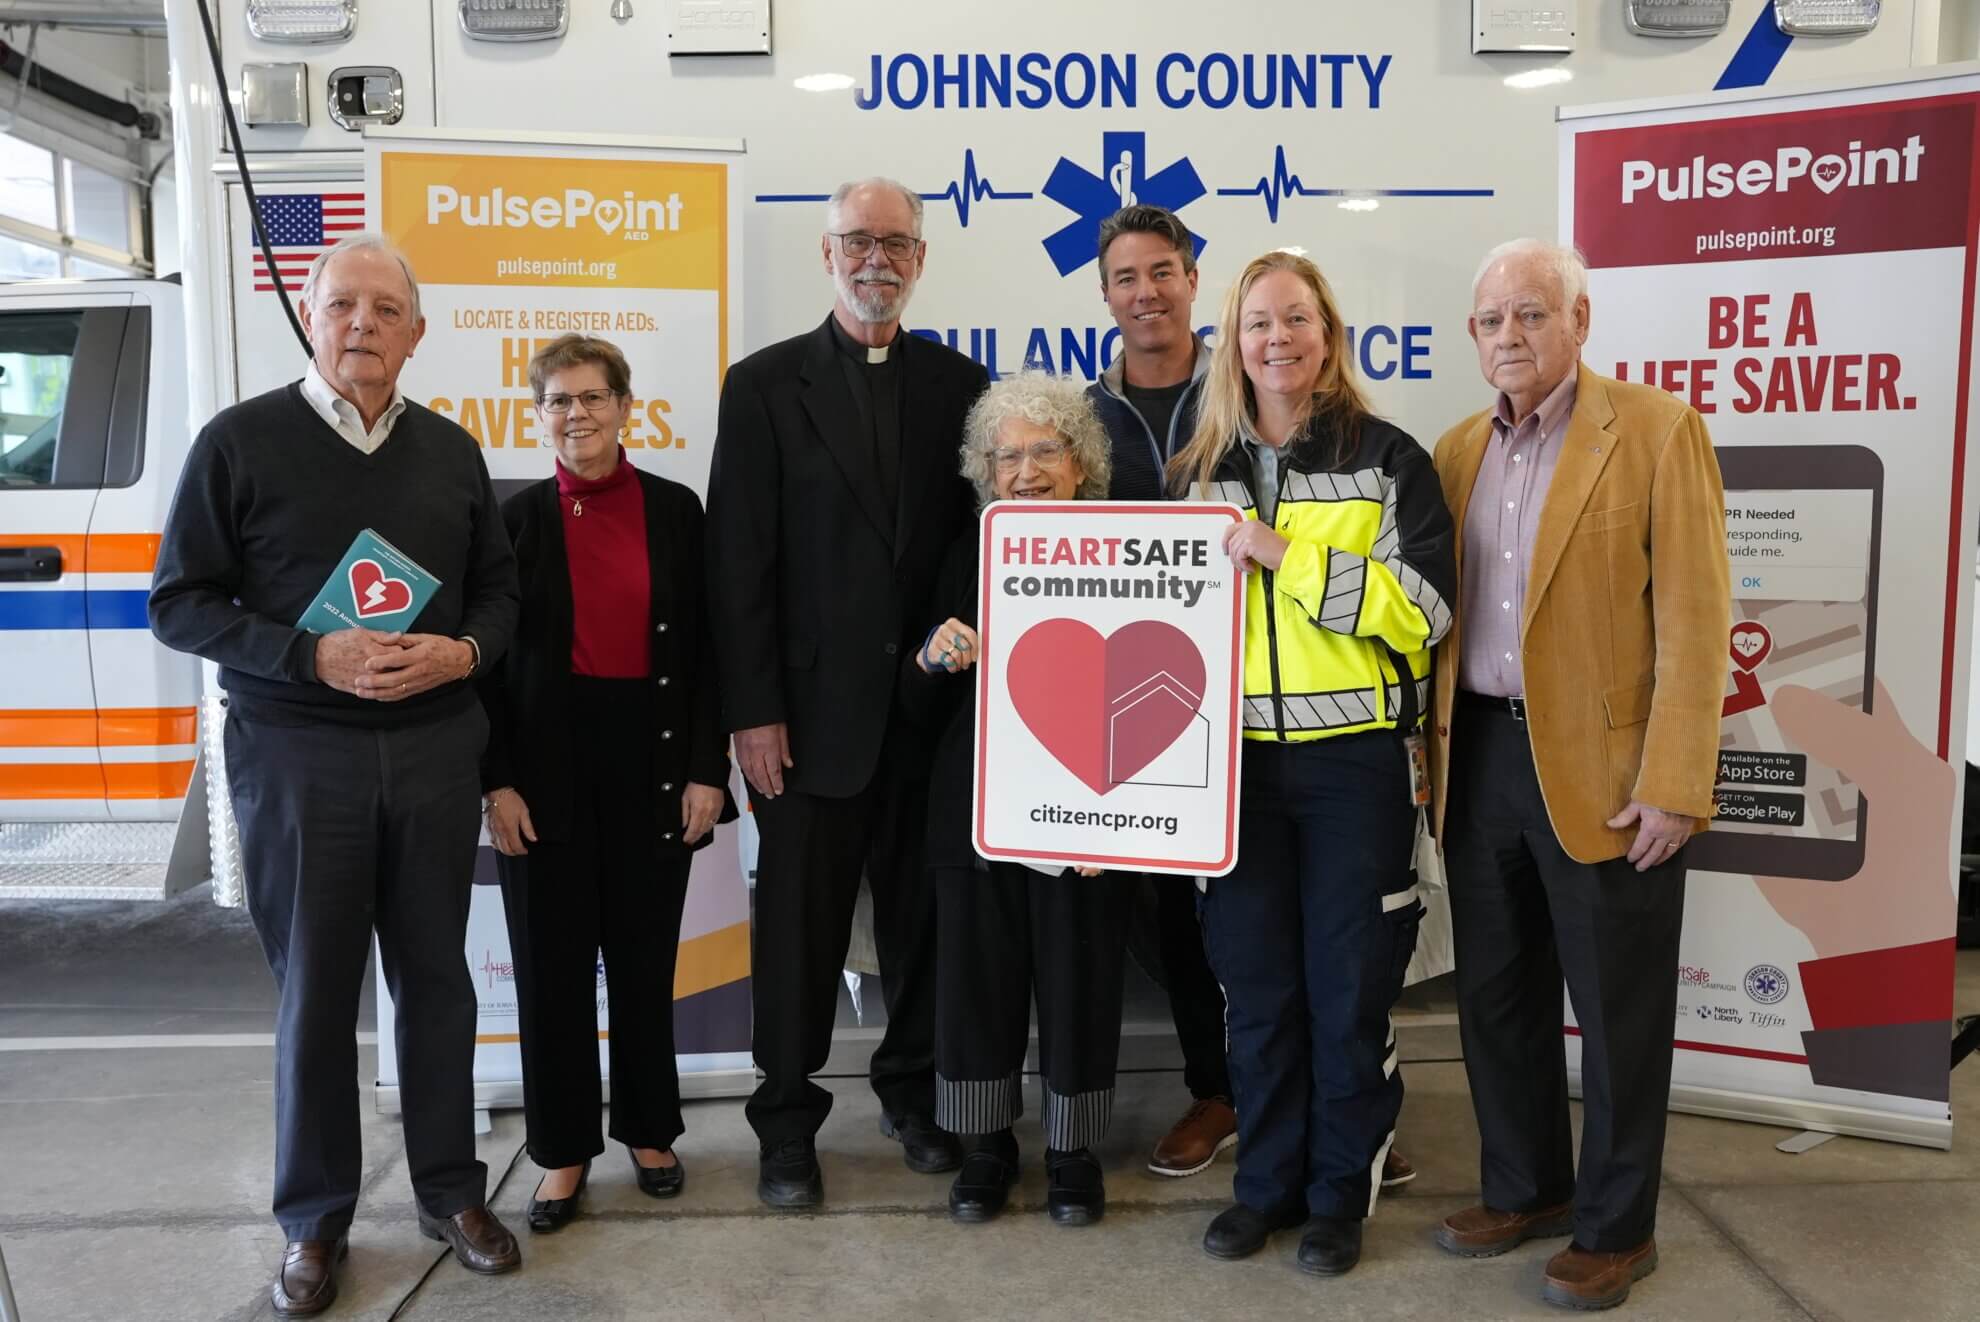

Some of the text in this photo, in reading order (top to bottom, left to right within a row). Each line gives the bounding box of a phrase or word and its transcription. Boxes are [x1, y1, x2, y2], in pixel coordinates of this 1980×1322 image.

[854, 52, 1393, 110] JOHNSON COUNTY
[1621, 135, 1926, 204] PulsePoint
[427, 184, 684, 236] PulsePoint
[623, 231, 650, 241] AED
[1696, 224, 1837, 255] pulsepoint.org
[497, 256, 617, 280] pulsepoint.org
[454, 309, 659, 332] LOCATE & REGISTER AEDs.
[1707, 291, 1818, 350] BE A
[1731, 352, 1917, 415] SAVER.
[1724, 508, 1795, 520] PR Needed
[1726, 528, 1803, 543] responding,
[1002, 536, 1208, 567] HEARTSAFE
[1726, 545, 1785, 557] uide me.
[1002, 569, 1207, 609] community
[1741, 577, 1761, 588] OK
[1721, 754, 1760, 764] Available
[1776, 756, 1791, 766] the
[1720, 763, 1795, 780] App Store
[1742, 794, 1755, 802] ON
[1029, 803, 1179, 836] citizencpr.org
[1716, 802, 1796, 822] Google Play
[1714, 1005, 1739, 1016] North
[1714, 1014, 1743, 1024] Liberty
[1749, 1012, 1786, 1028] Tiffin
